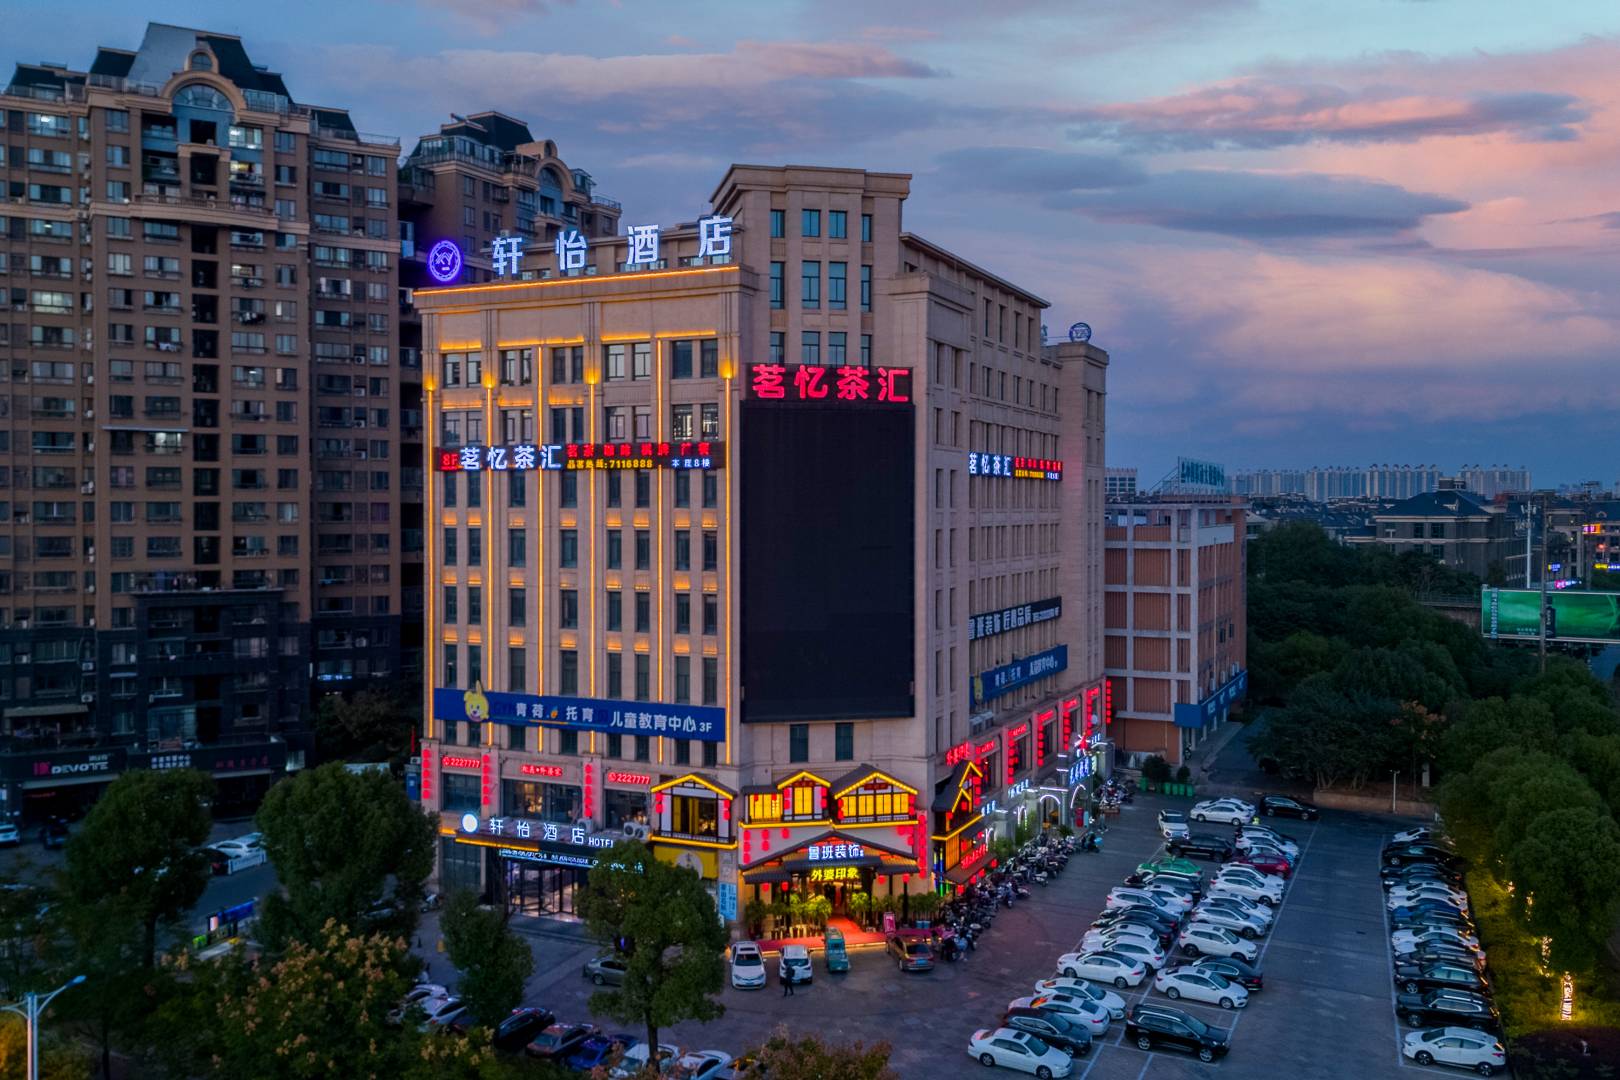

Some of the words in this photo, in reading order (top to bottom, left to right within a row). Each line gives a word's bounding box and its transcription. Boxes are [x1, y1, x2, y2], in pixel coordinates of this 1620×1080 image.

[491, 215, 734, 275] 轩怡酒店
[752, 364, 909, 402] 茗忆茶汇
[460, 445, 562, 470] 茗忆茶汇
[610, 711, 697, 733] 儿童教育中心
[699, 722, 713, 733] 3F
[51, 761, 109, 775] DEVOTE
[617, 773, 650, 785] 2227777
[489, 817, 585, 844] 轩怡酒店
[811, 867, 860, 881] 外婆印象
